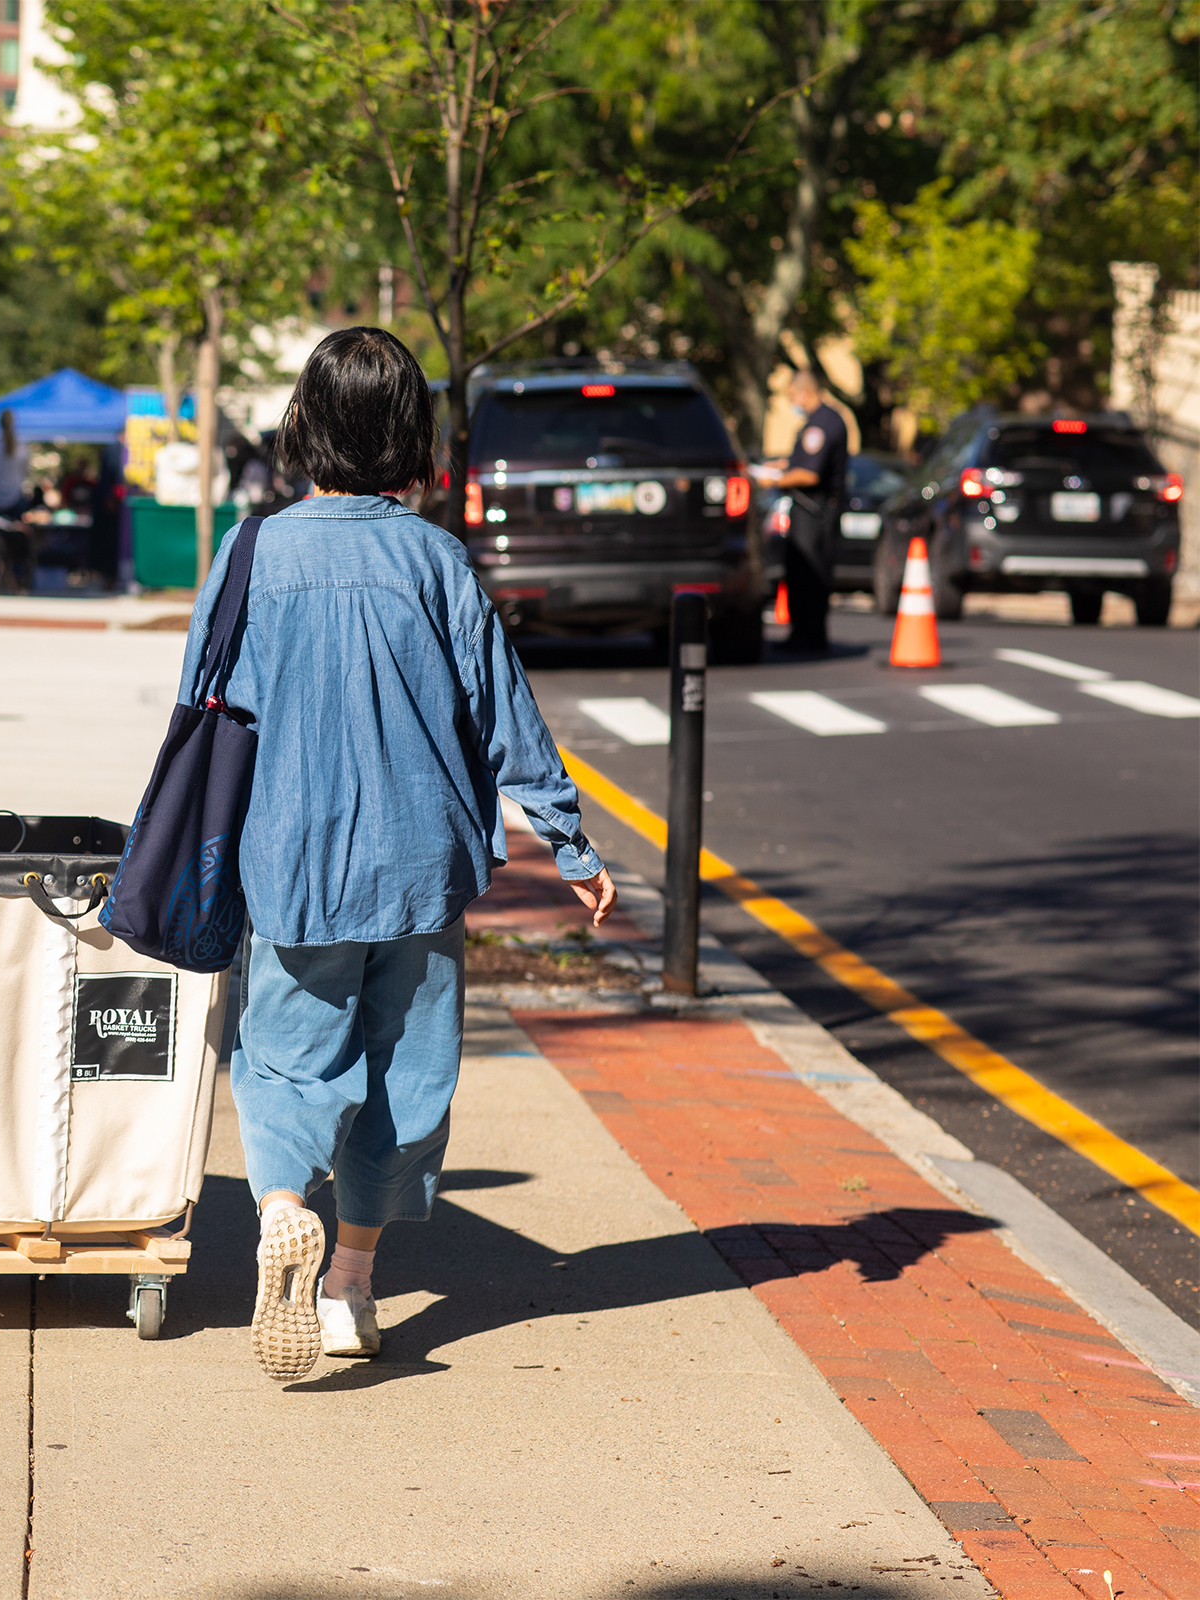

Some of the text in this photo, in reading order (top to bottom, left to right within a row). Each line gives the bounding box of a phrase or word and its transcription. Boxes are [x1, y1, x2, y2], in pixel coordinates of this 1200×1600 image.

[88, 1008, 157, 1039] ROYAL
[76, 1068, 94, 1077] 8 BU
